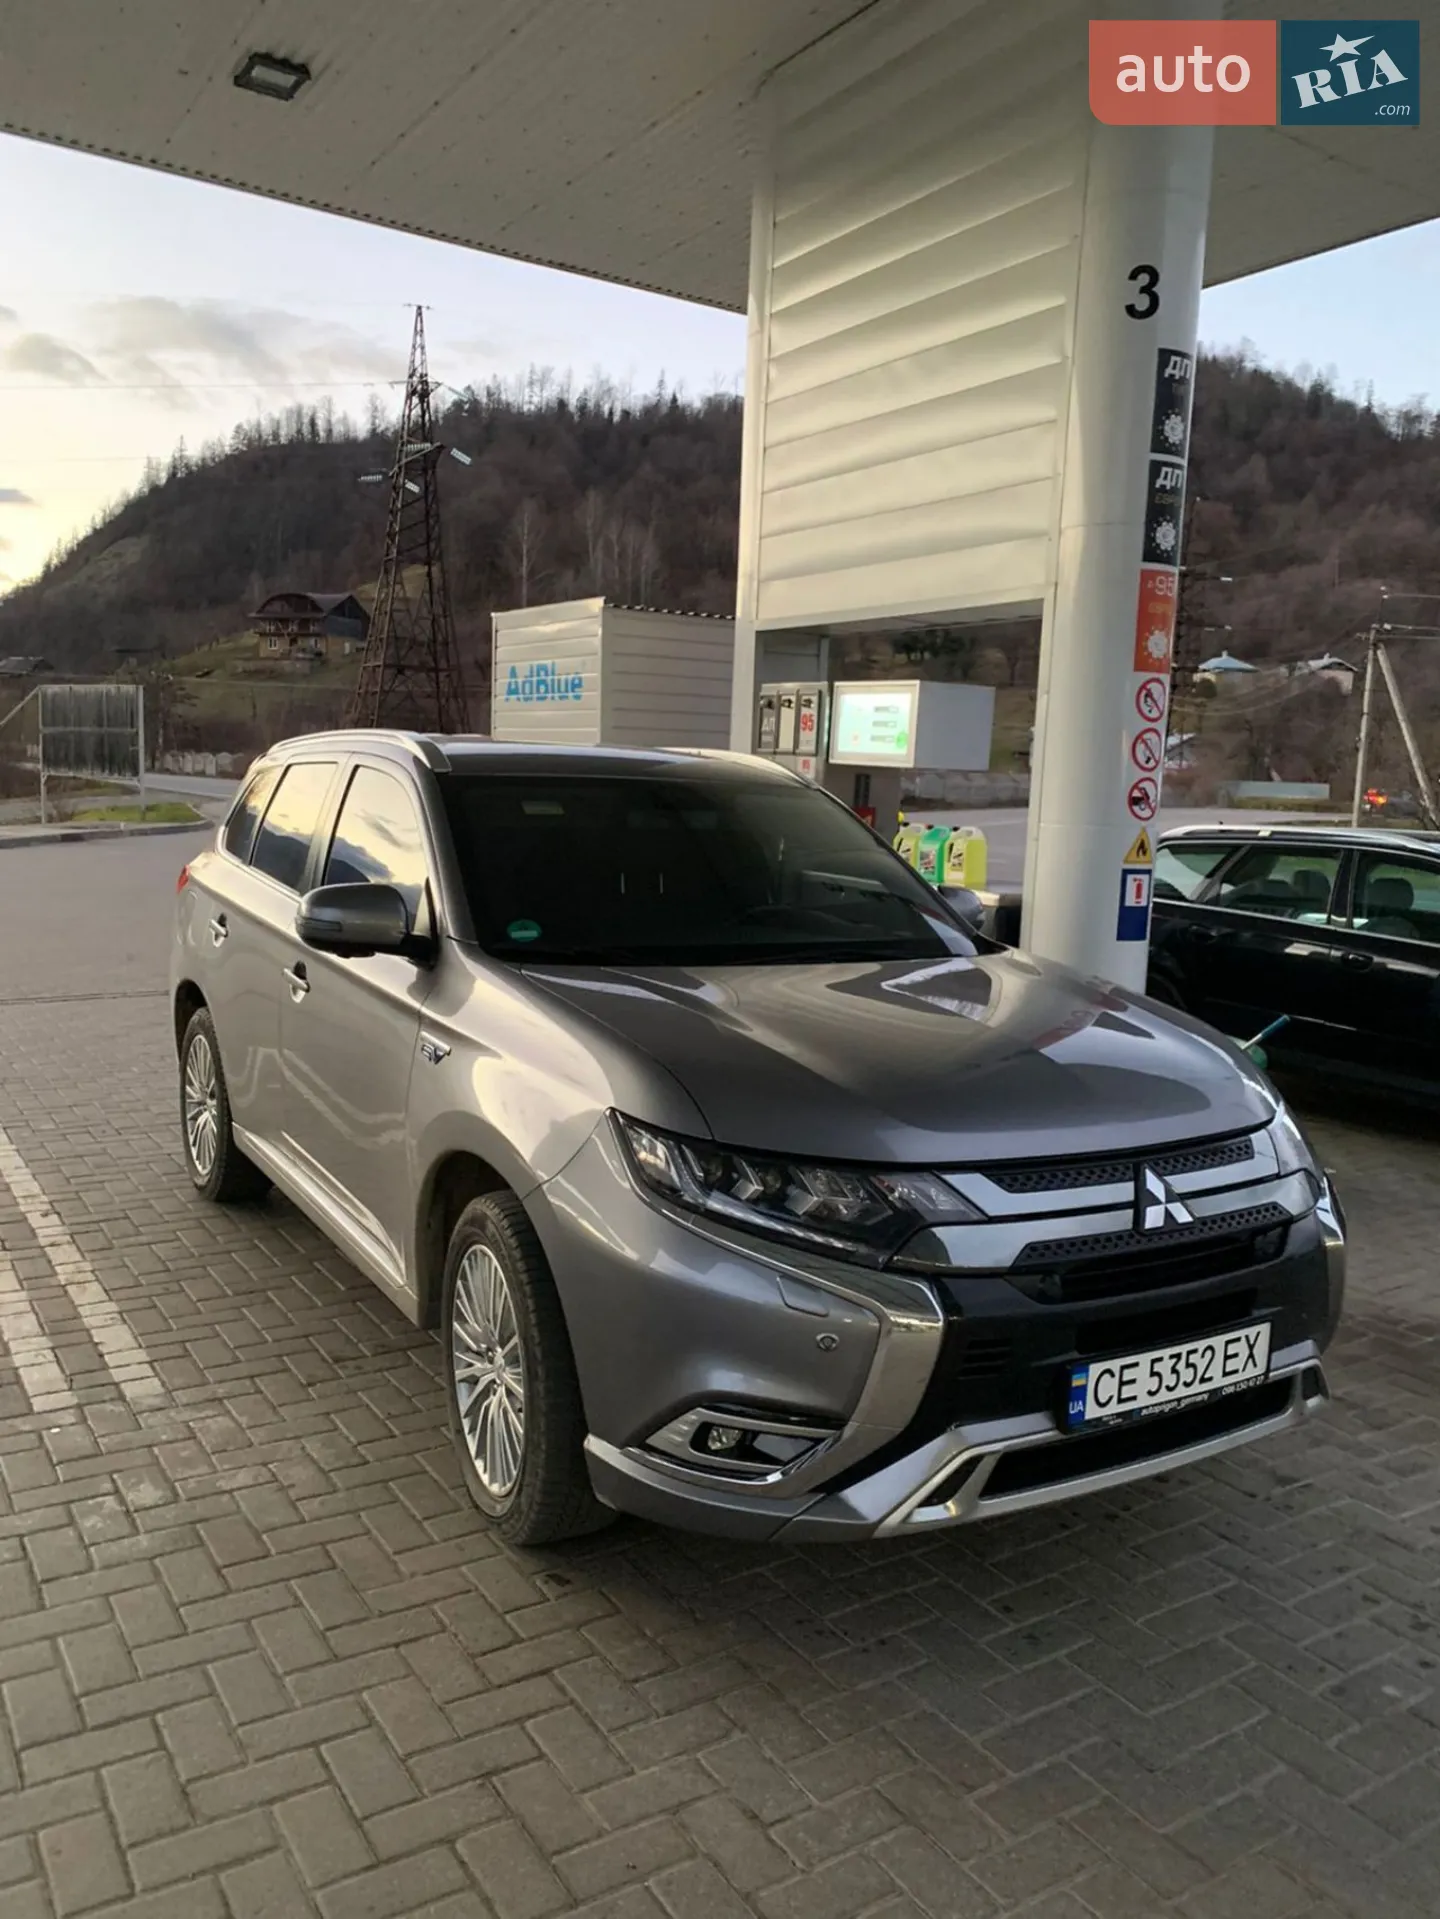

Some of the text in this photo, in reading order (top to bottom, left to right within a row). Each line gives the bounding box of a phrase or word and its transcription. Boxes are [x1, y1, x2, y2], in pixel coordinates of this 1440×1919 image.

[1124, 264, 1160, 320] 3
[1164, 355, 1192, 379] ДП
[1155, 466, 1183, 489] ДП
[504, 661, 584, 702] AdBlue
[801, 712, 815, 732] 95
[1093, 1331, 1261, 1408] CE 5352 EX
[1069, 1401, 1084, 1414] UA
